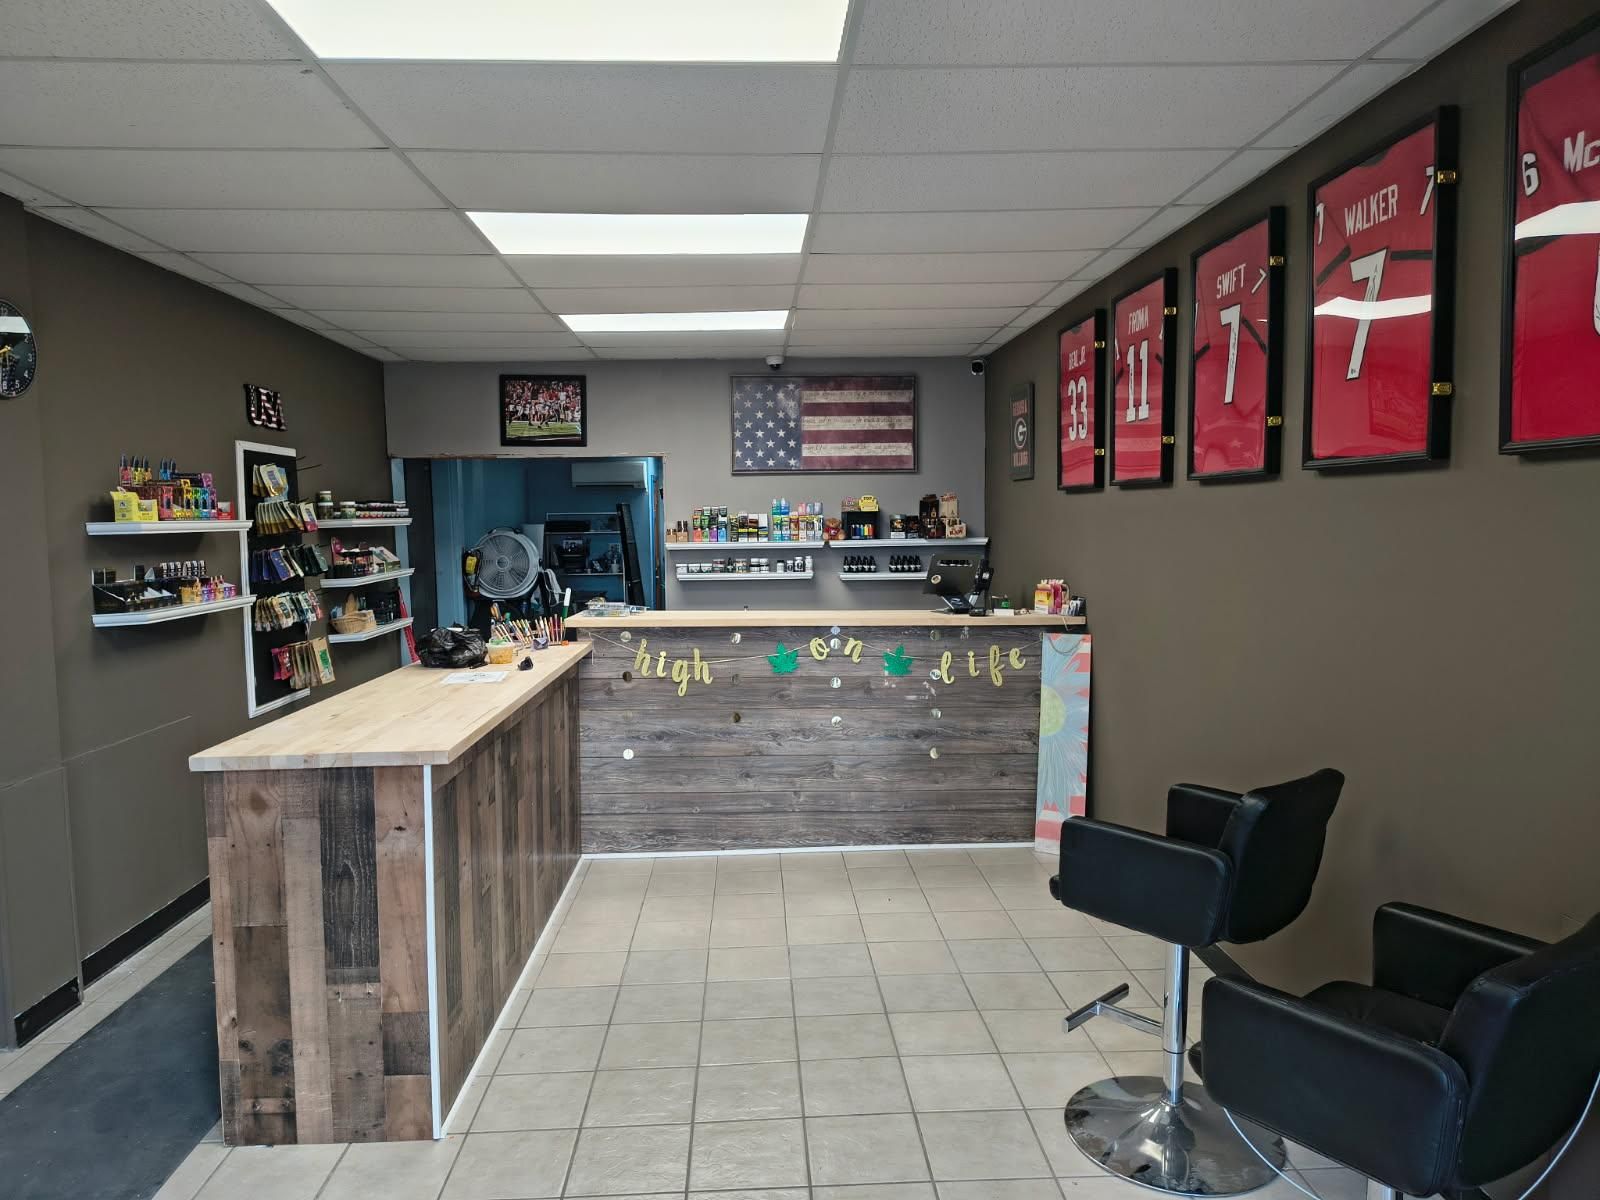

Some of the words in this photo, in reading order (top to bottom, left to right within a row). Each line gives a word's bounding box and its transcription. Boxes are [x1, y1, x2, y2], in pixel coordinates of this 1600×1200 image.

[1420, 165, 1434, 216] 7
[1522, 152, 1541, 197] 6
[1344, 183, 1399, 238] WALKER
[1216, 262, 1247, 300] SWIFT
[1345, 248, 1389, 381] 7
[1126, 338, 1149, 423] 11
[1219, 303, 1241, 405] 7
[244, 384, 288, 432] USA
[1067, 375, 1088, 441] 33
[633, 638, 714, 698] high
[809, 636, 864, 664] on
[940, 644, 1026, 687] life
